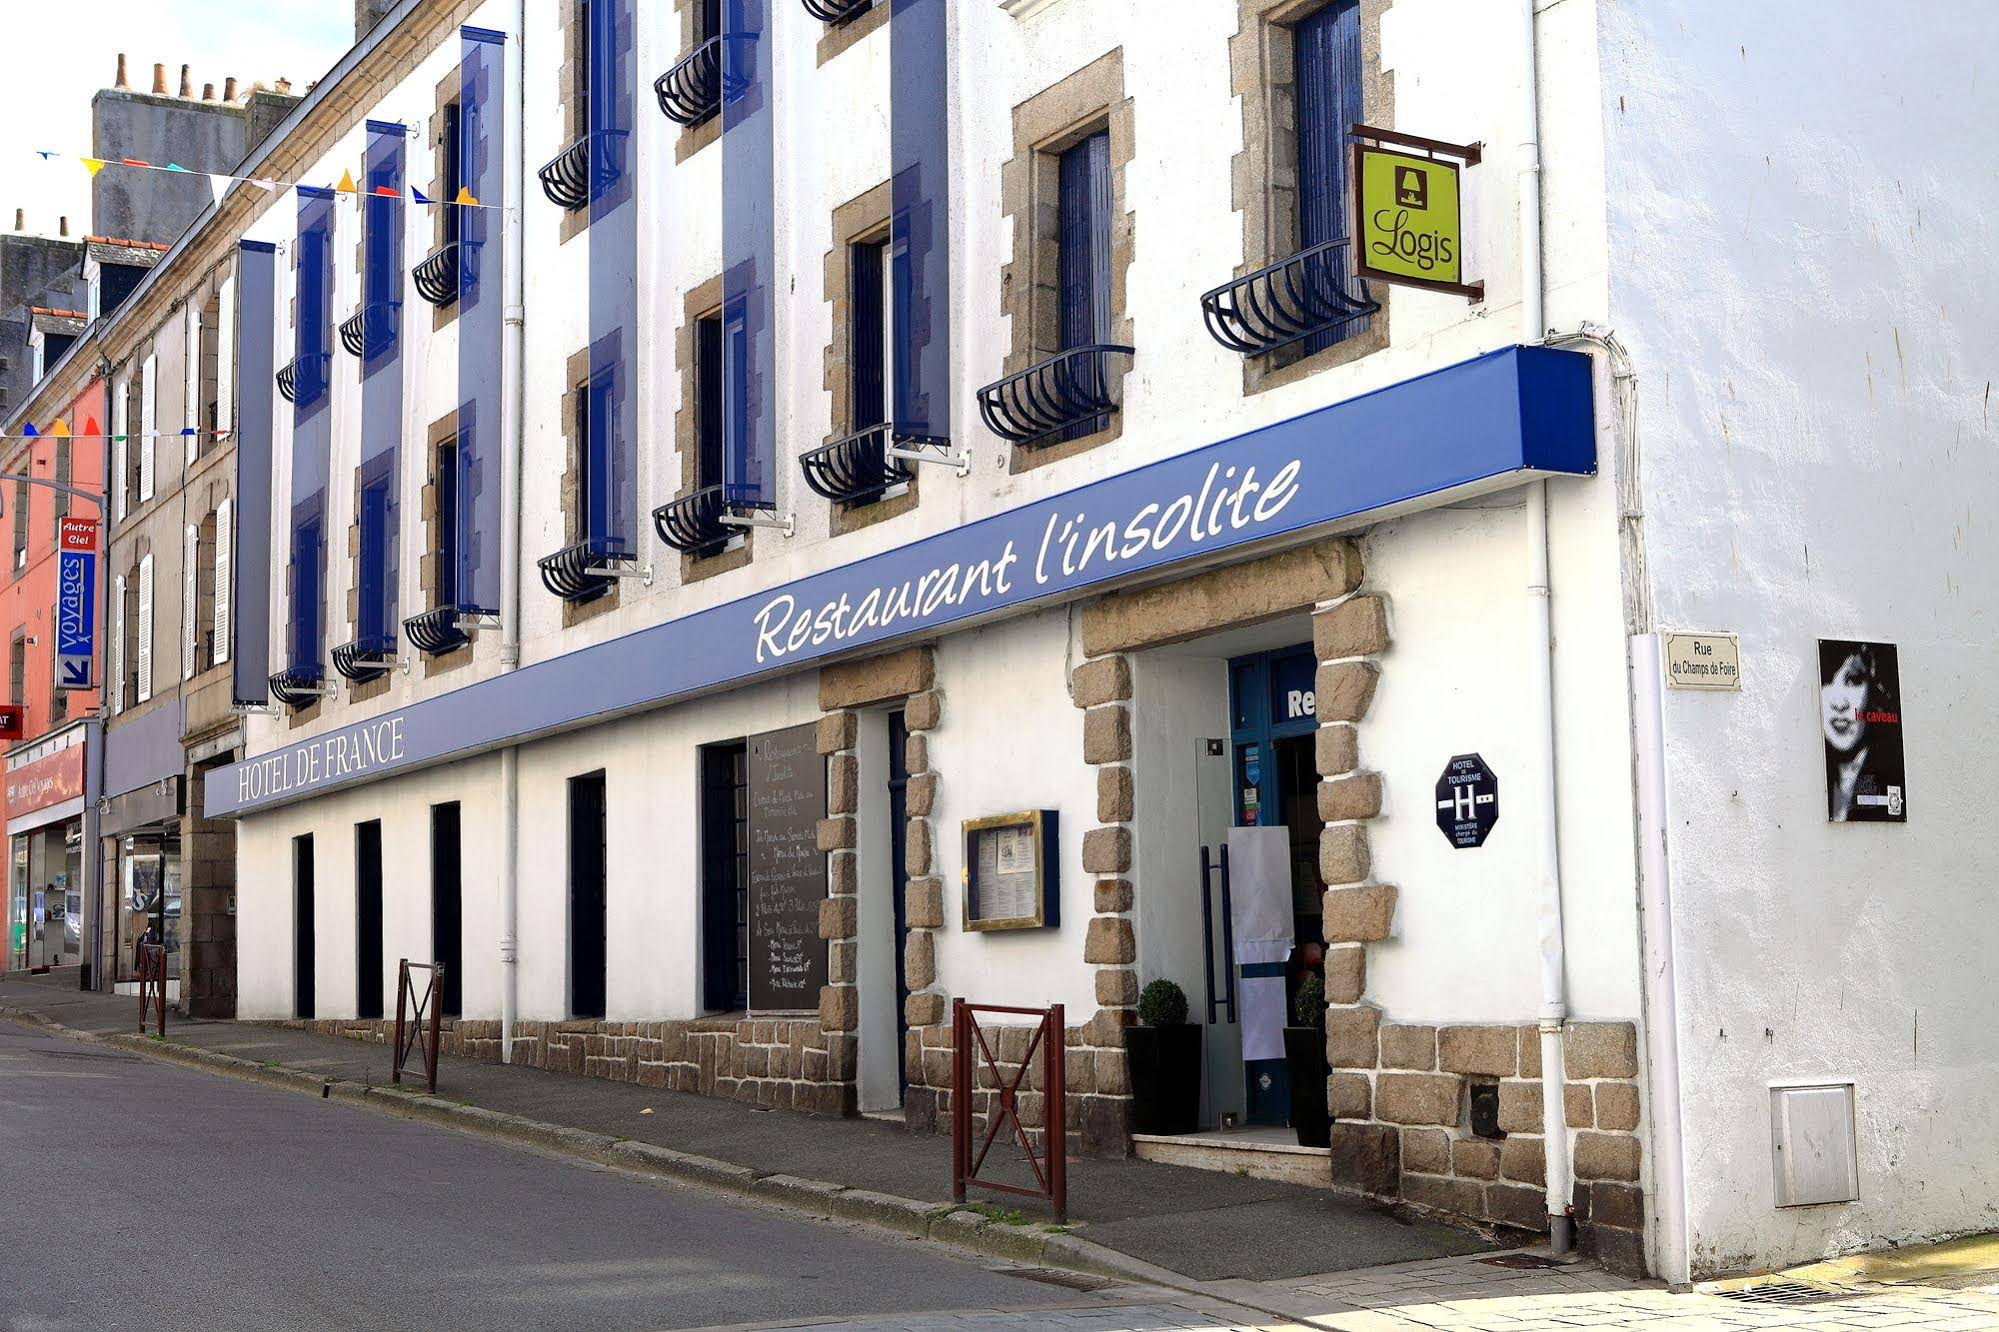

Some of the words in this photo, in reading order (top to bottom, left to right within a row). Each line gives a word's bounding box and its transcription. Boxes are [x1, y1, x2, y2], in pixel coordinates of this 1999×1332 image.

[1372, 209, 1452, 271] Logis
[63, 522, 95, 533] Autre
[68, 535, 89, 545] Ciel
[753, 539, 1017, 664] Restaurant
[1034, 459, 1302, 585] l'insolite
[61, 558, 85, 649] voyages
[1694, 641, 1712, 656] Rue
[1672, 660, 1682, 673] du
[1682, 660, 1709, 678] Champs
[1710, 661, 1718, 675] de
[1719, 661, 1736, 676] Foire
[1866, 711, 1898, 723] caveau
[238, 753, 293, 803] HOTEL
[295, 743, 320, 787] DE
[325, 717, 404, 778] FRANCE
[1452, 760, 1475, 769] HOTEL
[1447, 773, 1482, 784] TOURISME
[1454, 784, 1477, 822] H
